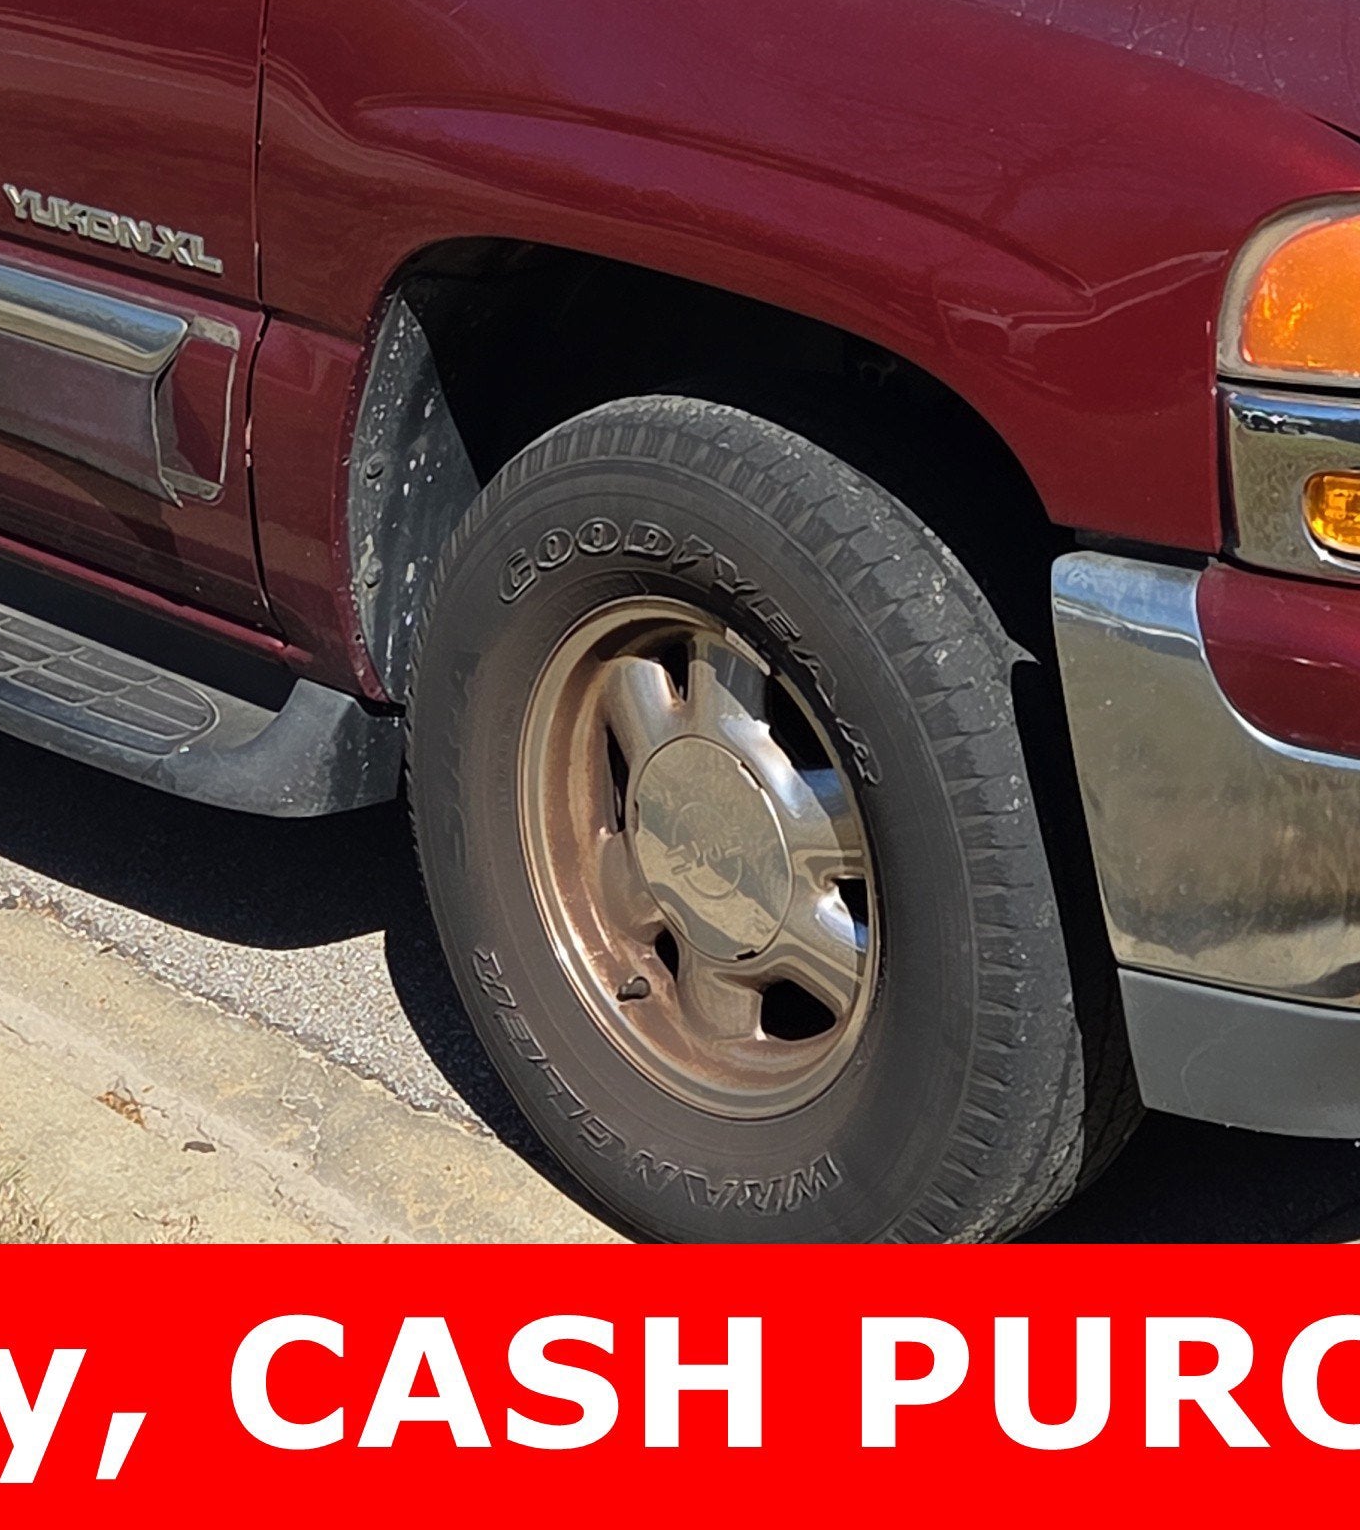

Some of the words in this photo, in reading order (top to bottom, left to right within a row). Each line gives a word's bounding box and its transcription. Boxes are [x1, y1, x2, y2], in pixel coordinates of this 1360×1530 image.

[2, 183, 153, 253] YUKON
[151, 224, 224, 274] XL
[498, 516, 882, 786] GOODYEAR
[472, 947, 843, 1216] WRANGLER
